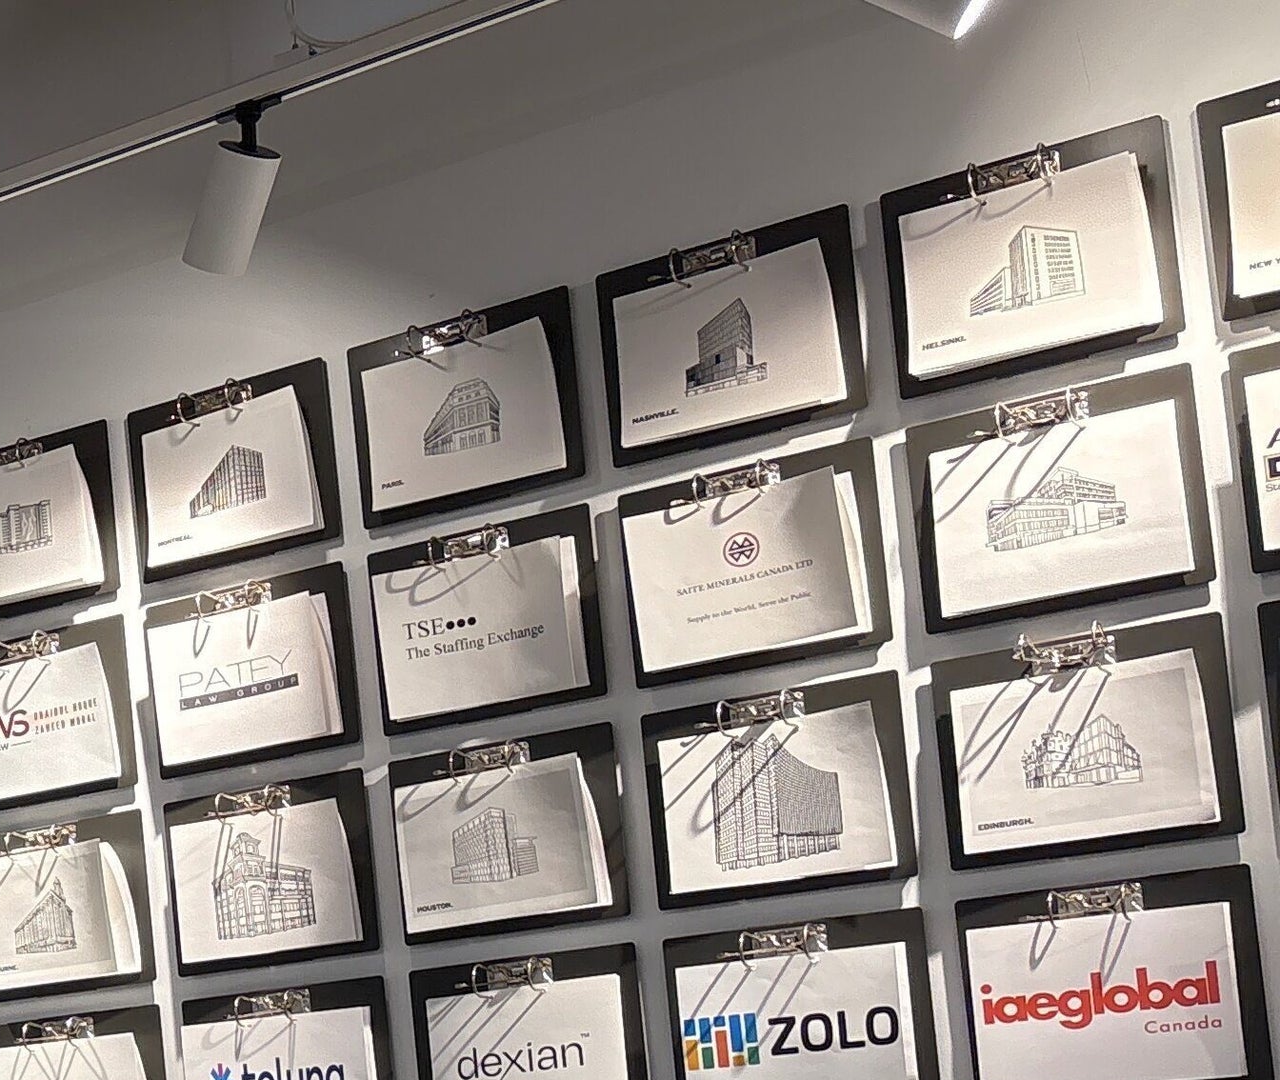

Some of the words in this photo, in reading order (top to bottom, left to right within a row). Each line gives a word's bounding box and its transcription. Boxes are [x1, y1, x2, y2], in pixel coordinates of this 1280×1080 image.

[676, 584, 705, 597] SAITE
[706, 573, 755, 591] MINERALS
[756, 563, 793, 579] CANADA
[794, 558, 814, 570] LTD
[405, 647, 431, 660] The
[433, 637, 485, 656] Staffing
[488, 623, 545, 646] Exchange
[179, 649, 292, 698] PATEY
[181, 695, 218, 709] LAW
[236, 676, 297, 698] GROUP
[980, 960, 1221, 1030] iaeglobal
[767, 1005, 899, 1056] ZOLO
[1144, 1015, 1223, 1034] Canada
